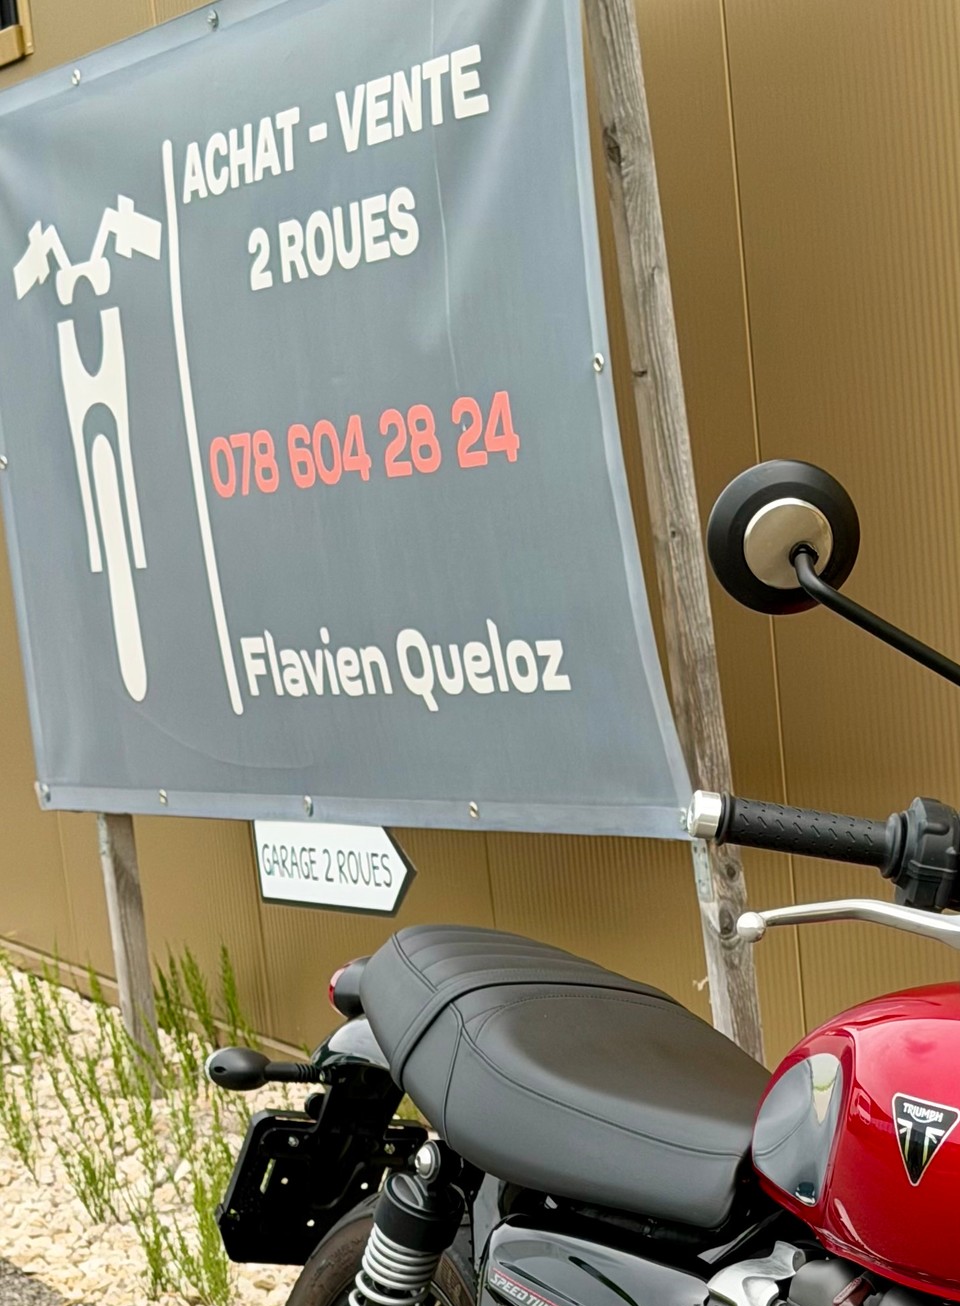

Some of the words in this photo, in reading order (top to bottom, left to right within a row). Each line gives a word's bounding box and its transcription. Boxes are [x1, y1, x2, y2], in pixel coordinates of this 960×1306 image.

[183, 107, 299, 203] ACHAT
[309, 122, 328, 143] -
[336, 44, 490, 153] VENTE
[249, 227, 274, 291] 2
[280, 187, 420, 282] ROUES
[210, 428, 280, 498] 078
[287, 413, 370, 488] 604
[379, 403, 441, 478] 28
[453, 391, 520, 469] 24
[240, 627, 392, 698] Flavien
[398, 619, 572, 713] Queloz
[262, 844, 318, 881] GARAGE
[323, 849, 334, 882] 2
[337, 850, 392, 888] ROUES
[903, 1102, 943, 1123] TRIUMPH
[490, 1273, 529, 1301] SPEED
